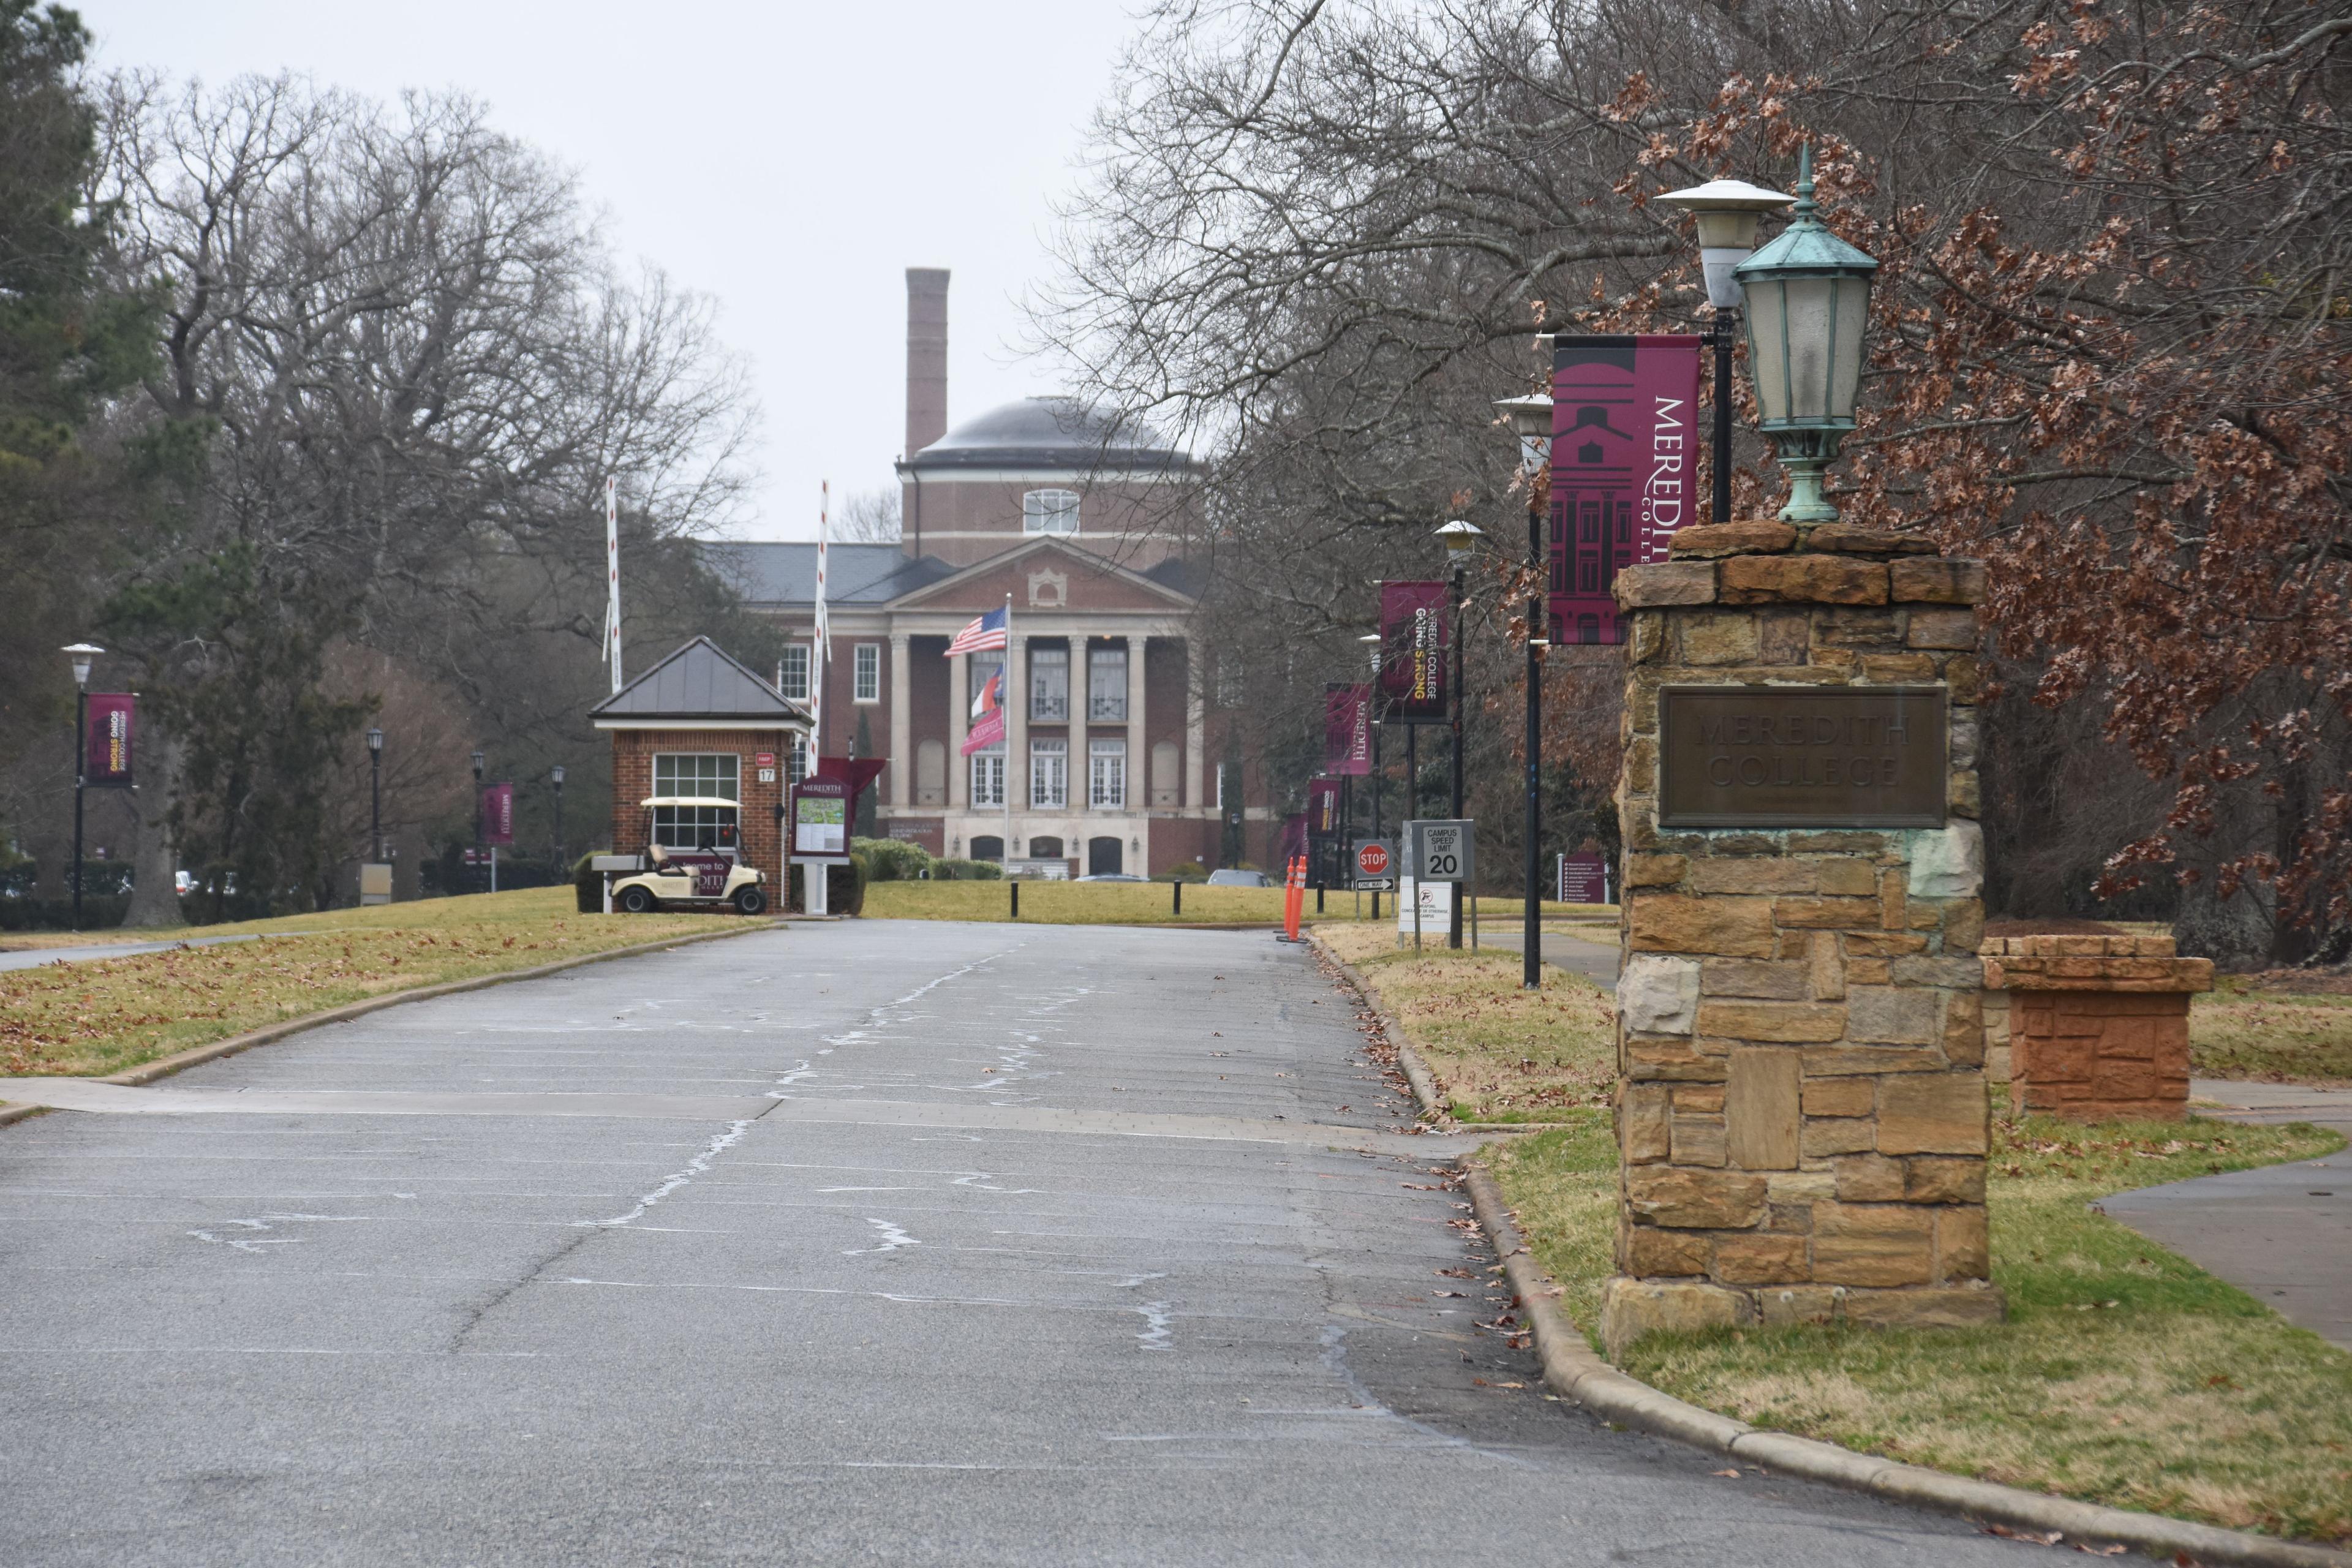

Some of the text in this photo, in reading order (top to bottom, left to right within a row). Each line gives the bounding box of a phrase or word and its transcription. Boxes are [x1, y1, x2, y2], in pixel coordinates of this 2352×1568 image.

[1645, 395, 1684, 556] MEREDI
[1642, 497, 1651, 563] COLLE
[1427, 657, 1436, 699] COLLEGE
[1355, 701, 1365, 760] MEREDITH
[1695, 715, 1910, 745] MEREDITH
[760, 770, 773, 781] 17
[1709, 755, 1898, 786] COLLEGE
[1361, 854, 1386, 865] STOP
[1430, 854, 1457, 874] 20
